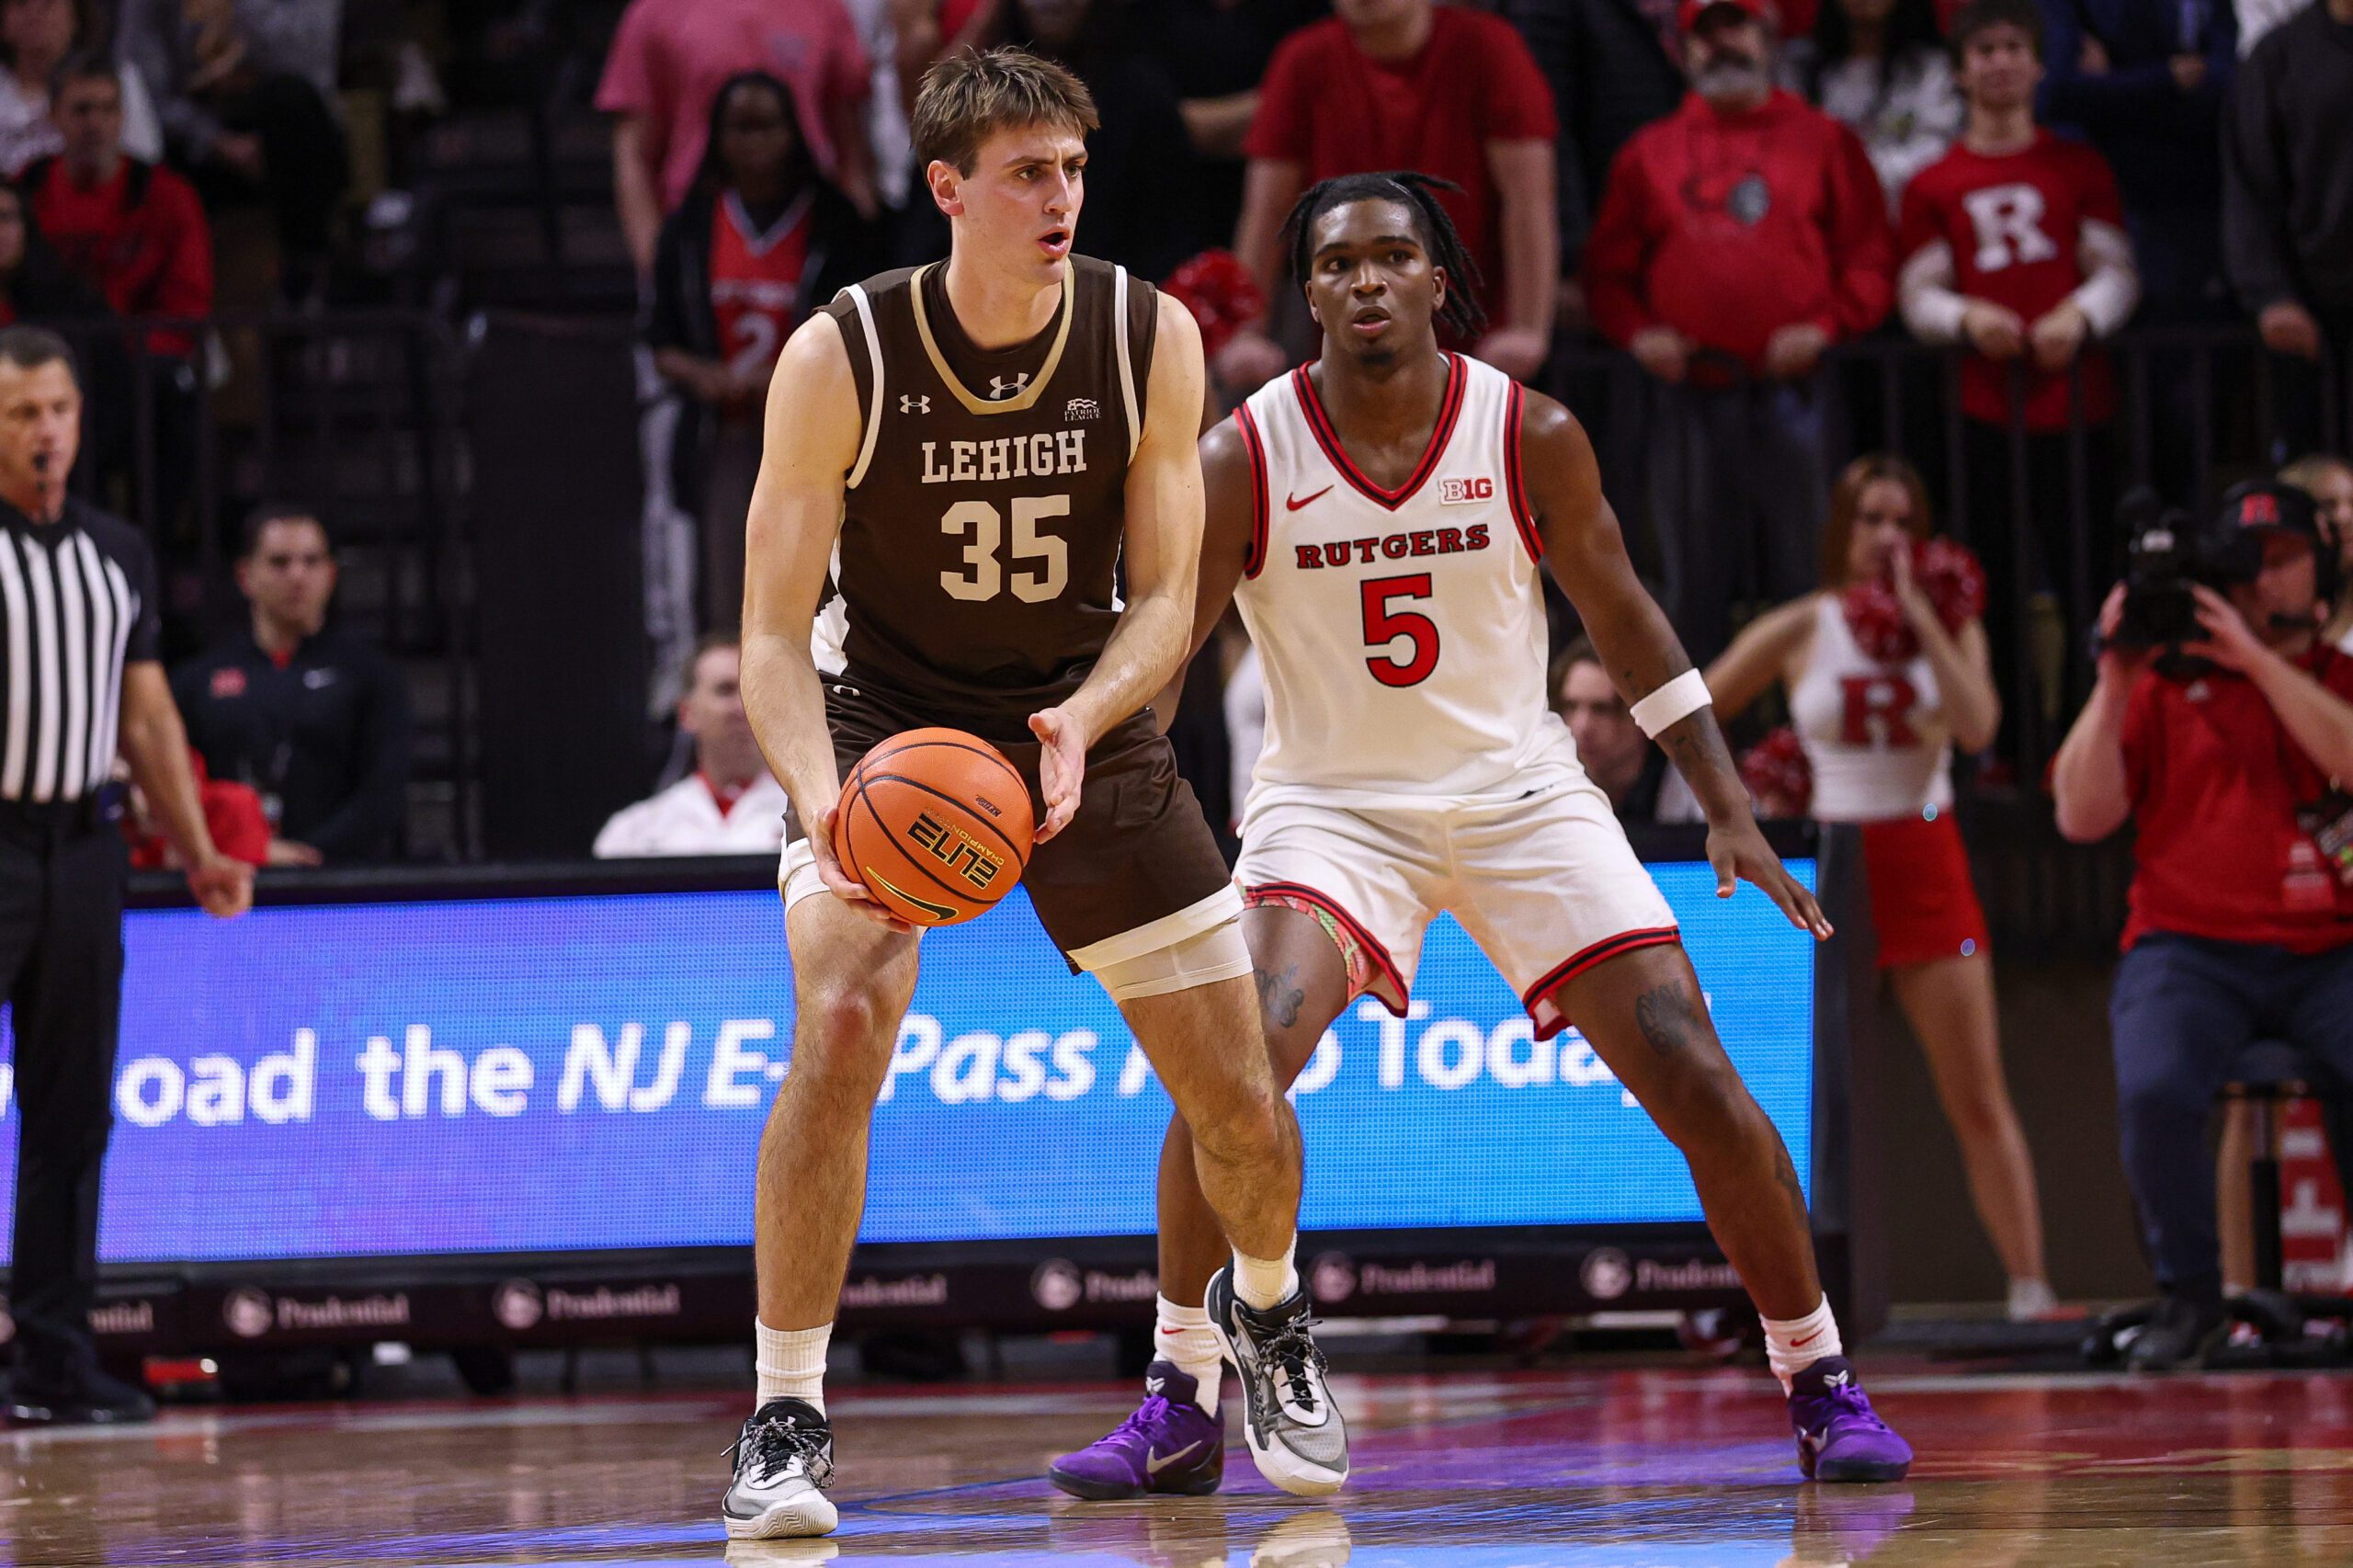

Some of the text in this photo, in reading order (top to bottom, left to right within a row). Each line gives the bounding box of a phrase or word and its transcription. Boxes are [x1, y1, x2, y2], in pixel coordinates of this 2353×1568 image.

[1962, 183, 2058, 273] R
[921, 429, 1087, 483] LEHIGH
[940, 494, 1070, 603] 35
[1295, 523, 1491, 569] RUTGERS
[1360, 572, 1440, 688] 5
[1841, 676, 1921, 749] R
[907, 812, 1000, 890] ELITE
[355, 1023, 535, 1120] the
[557, 1020, 693, 1115] NJ
[1358, 991, 1712, 1108] Toda
